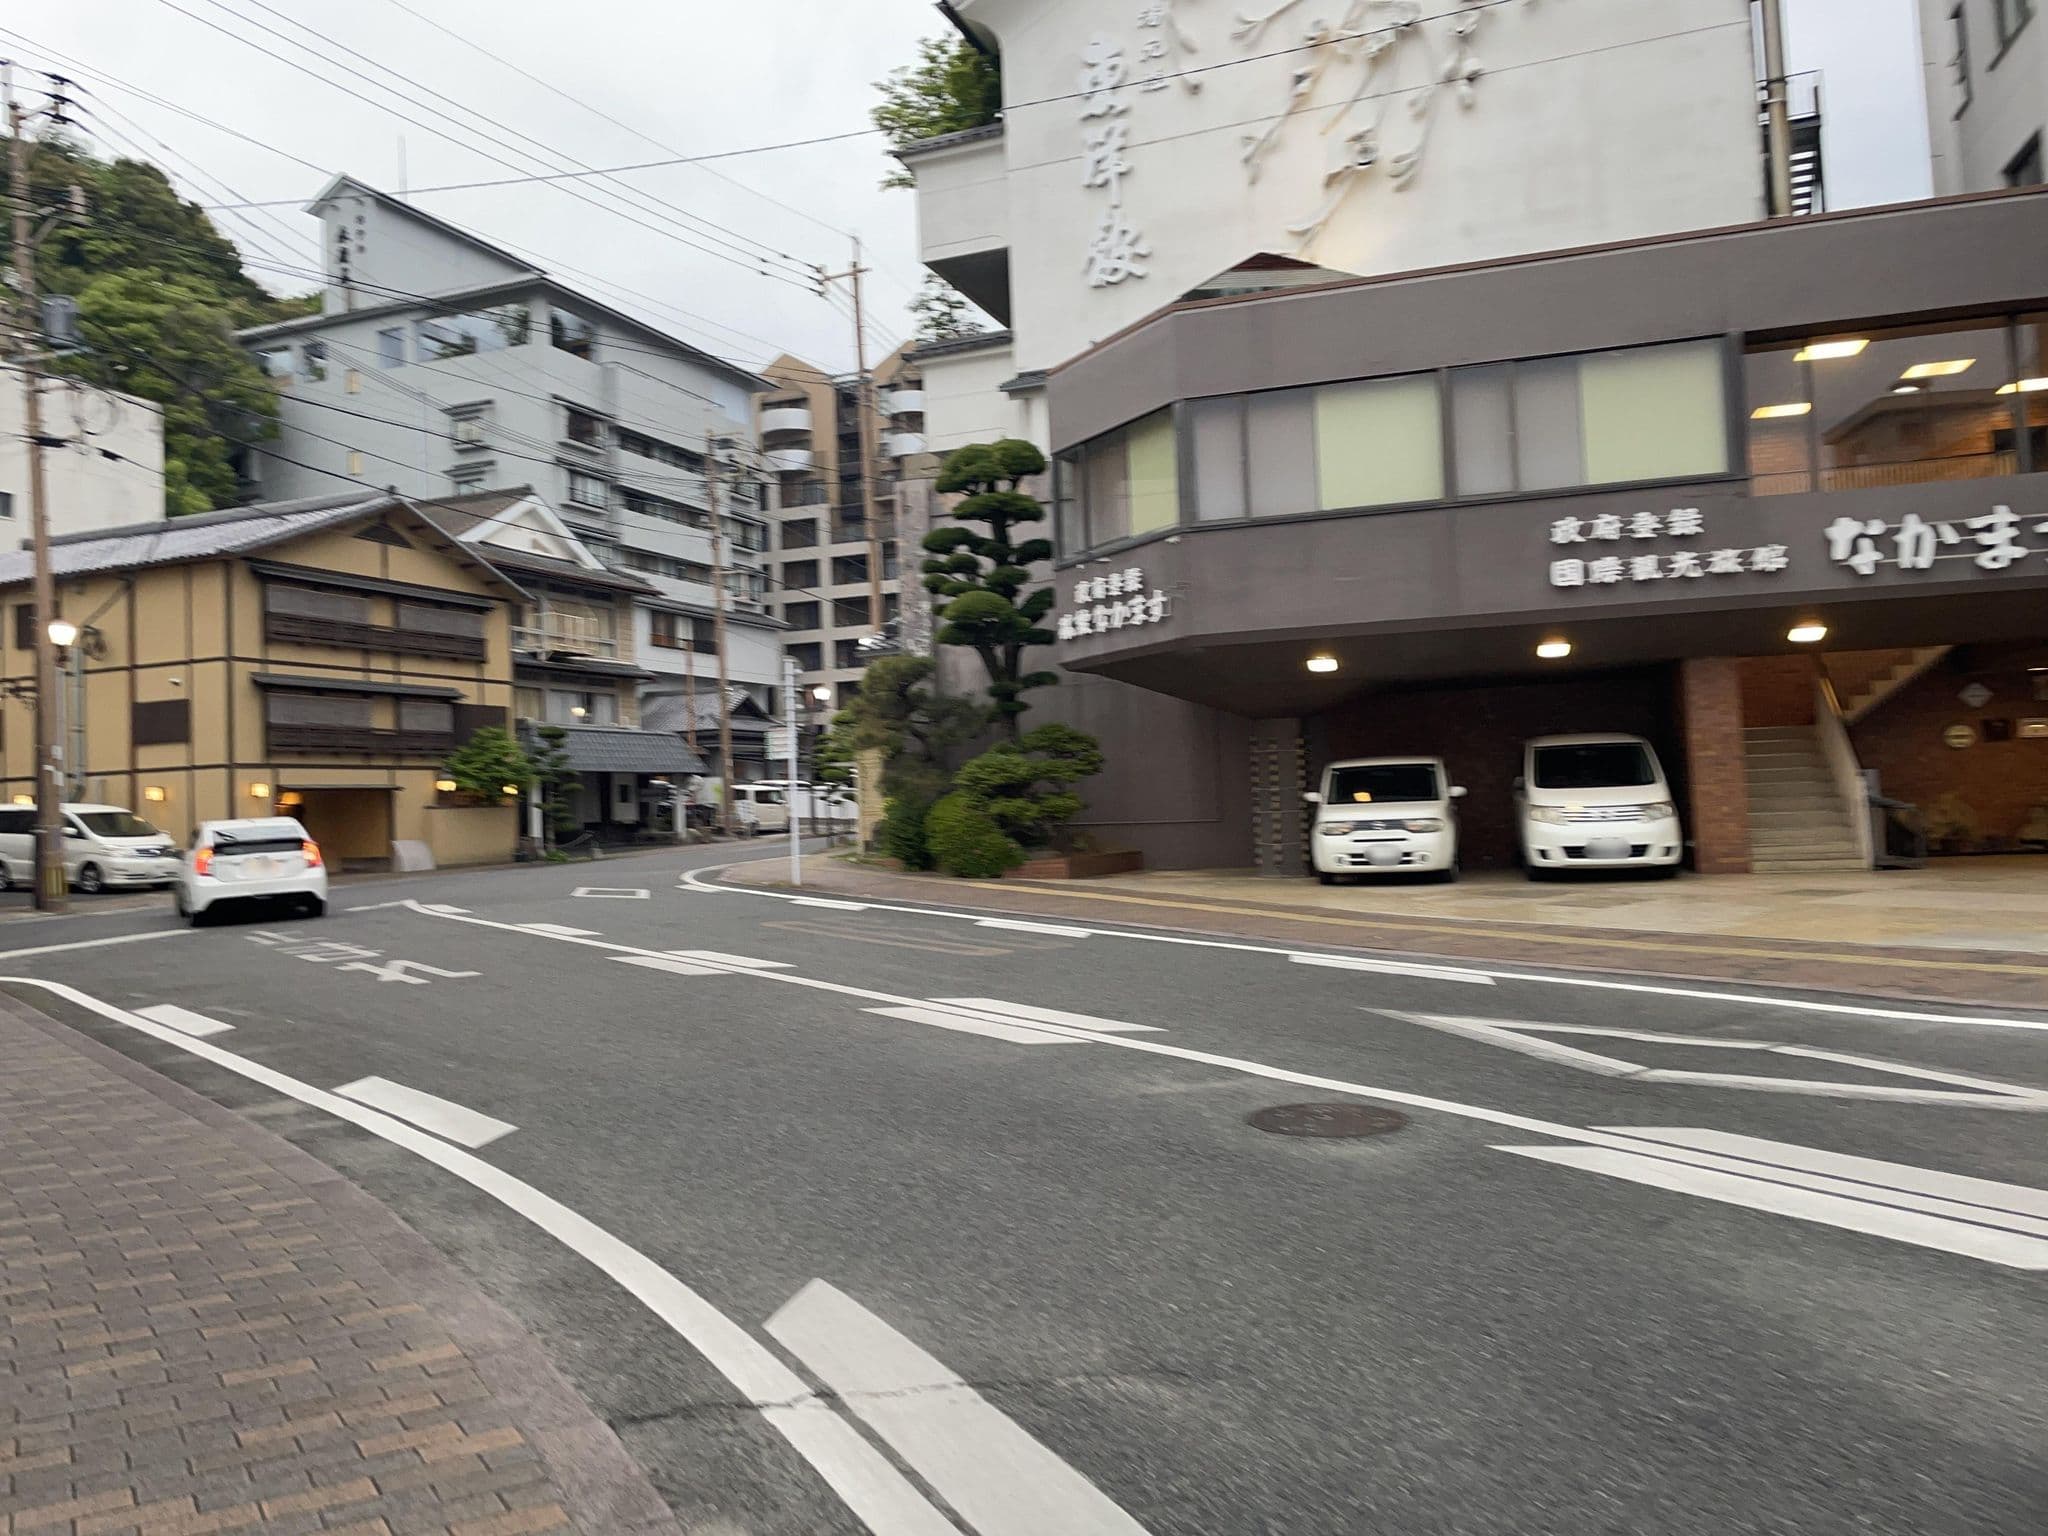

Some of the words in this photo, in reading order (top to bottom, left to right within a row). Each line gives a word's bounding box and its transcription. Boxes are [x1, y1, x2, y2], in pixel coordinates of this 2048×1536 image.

[1550, 507, 1704, 544] 政府登録
[1824, 505, 2048, 575] なかま
[1549, 544, 1789, 587] 国際観光旅館
